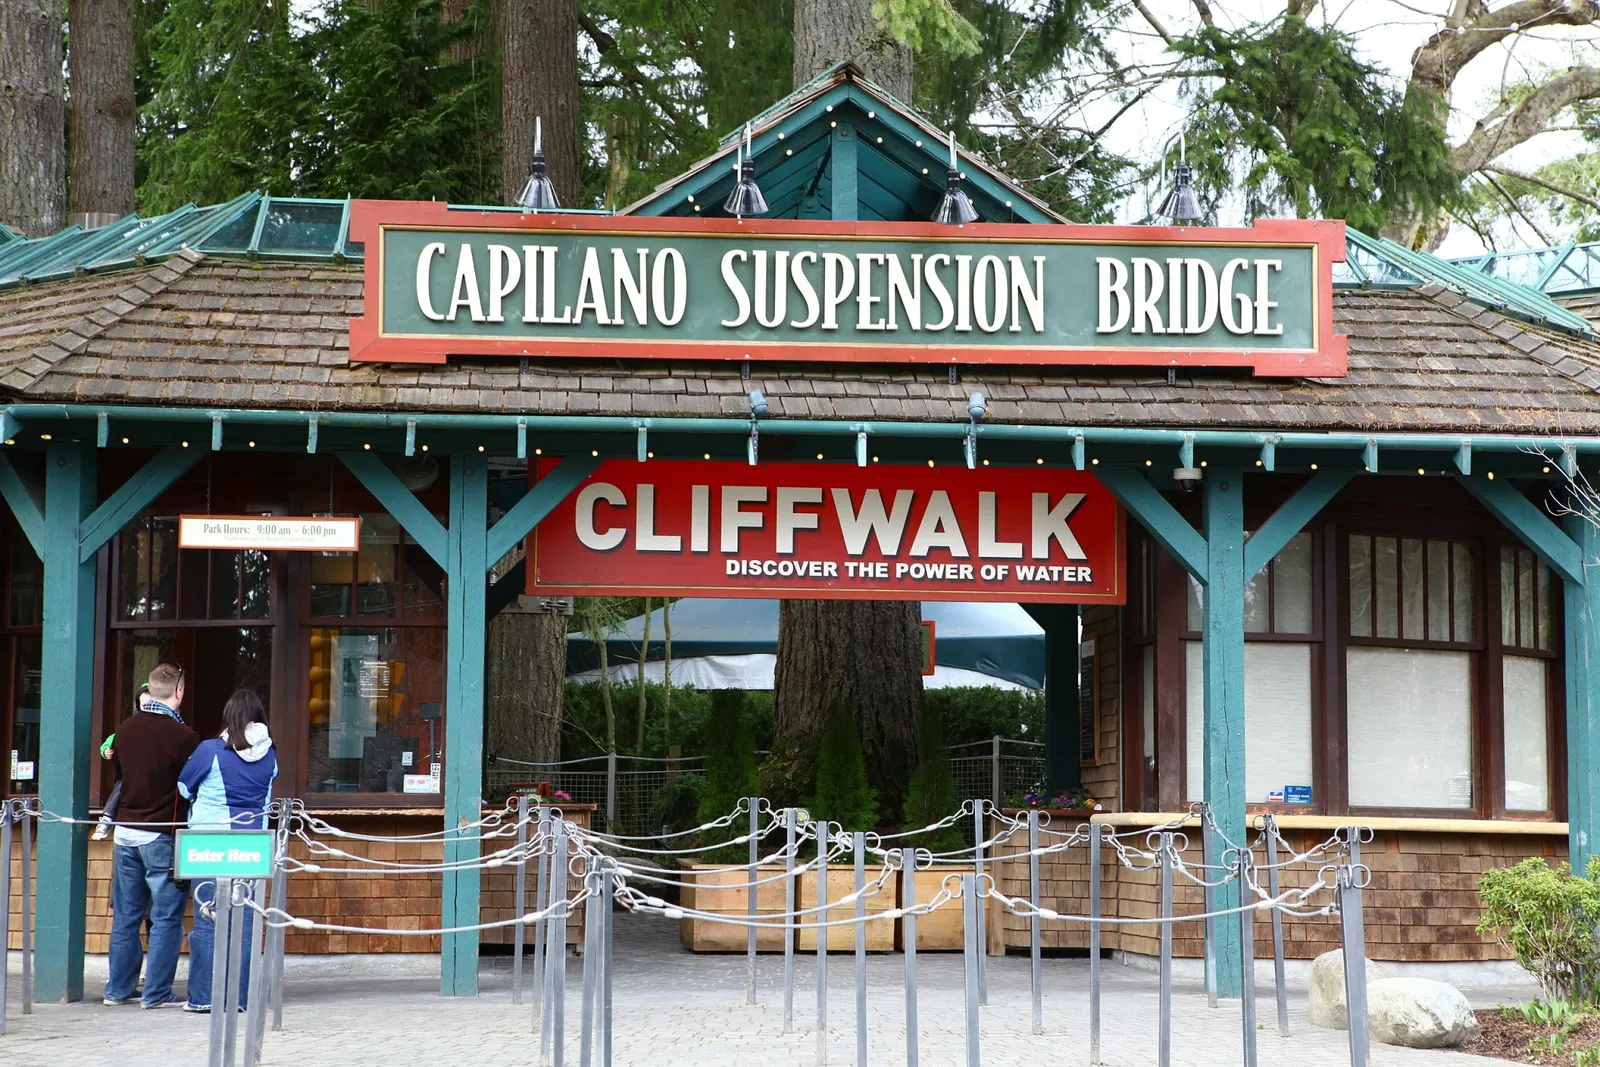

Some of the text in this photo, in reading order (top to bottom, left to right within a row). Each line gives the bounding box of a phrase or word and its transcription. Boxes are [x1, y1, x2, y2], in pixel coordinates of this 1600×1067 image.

[416, 242, 1284, 335] CAPILANO SUSPENSION BRIDGE
[203, 523, 222, 534] Park
[223, 524, 250, 535] Hours:
[257, 525, 277, 535] 9:00
[278, 526, 291, 535] am
[301, 525, 321, 536] 6:00
[323, 527, 337, 537] pm
[574, 482, 1088, 560] CLIFFWALK
[726, 559, 1092, 582] DISCOVER THE POWER OF WATER
[188, 849, 260, 863] Enter Here
